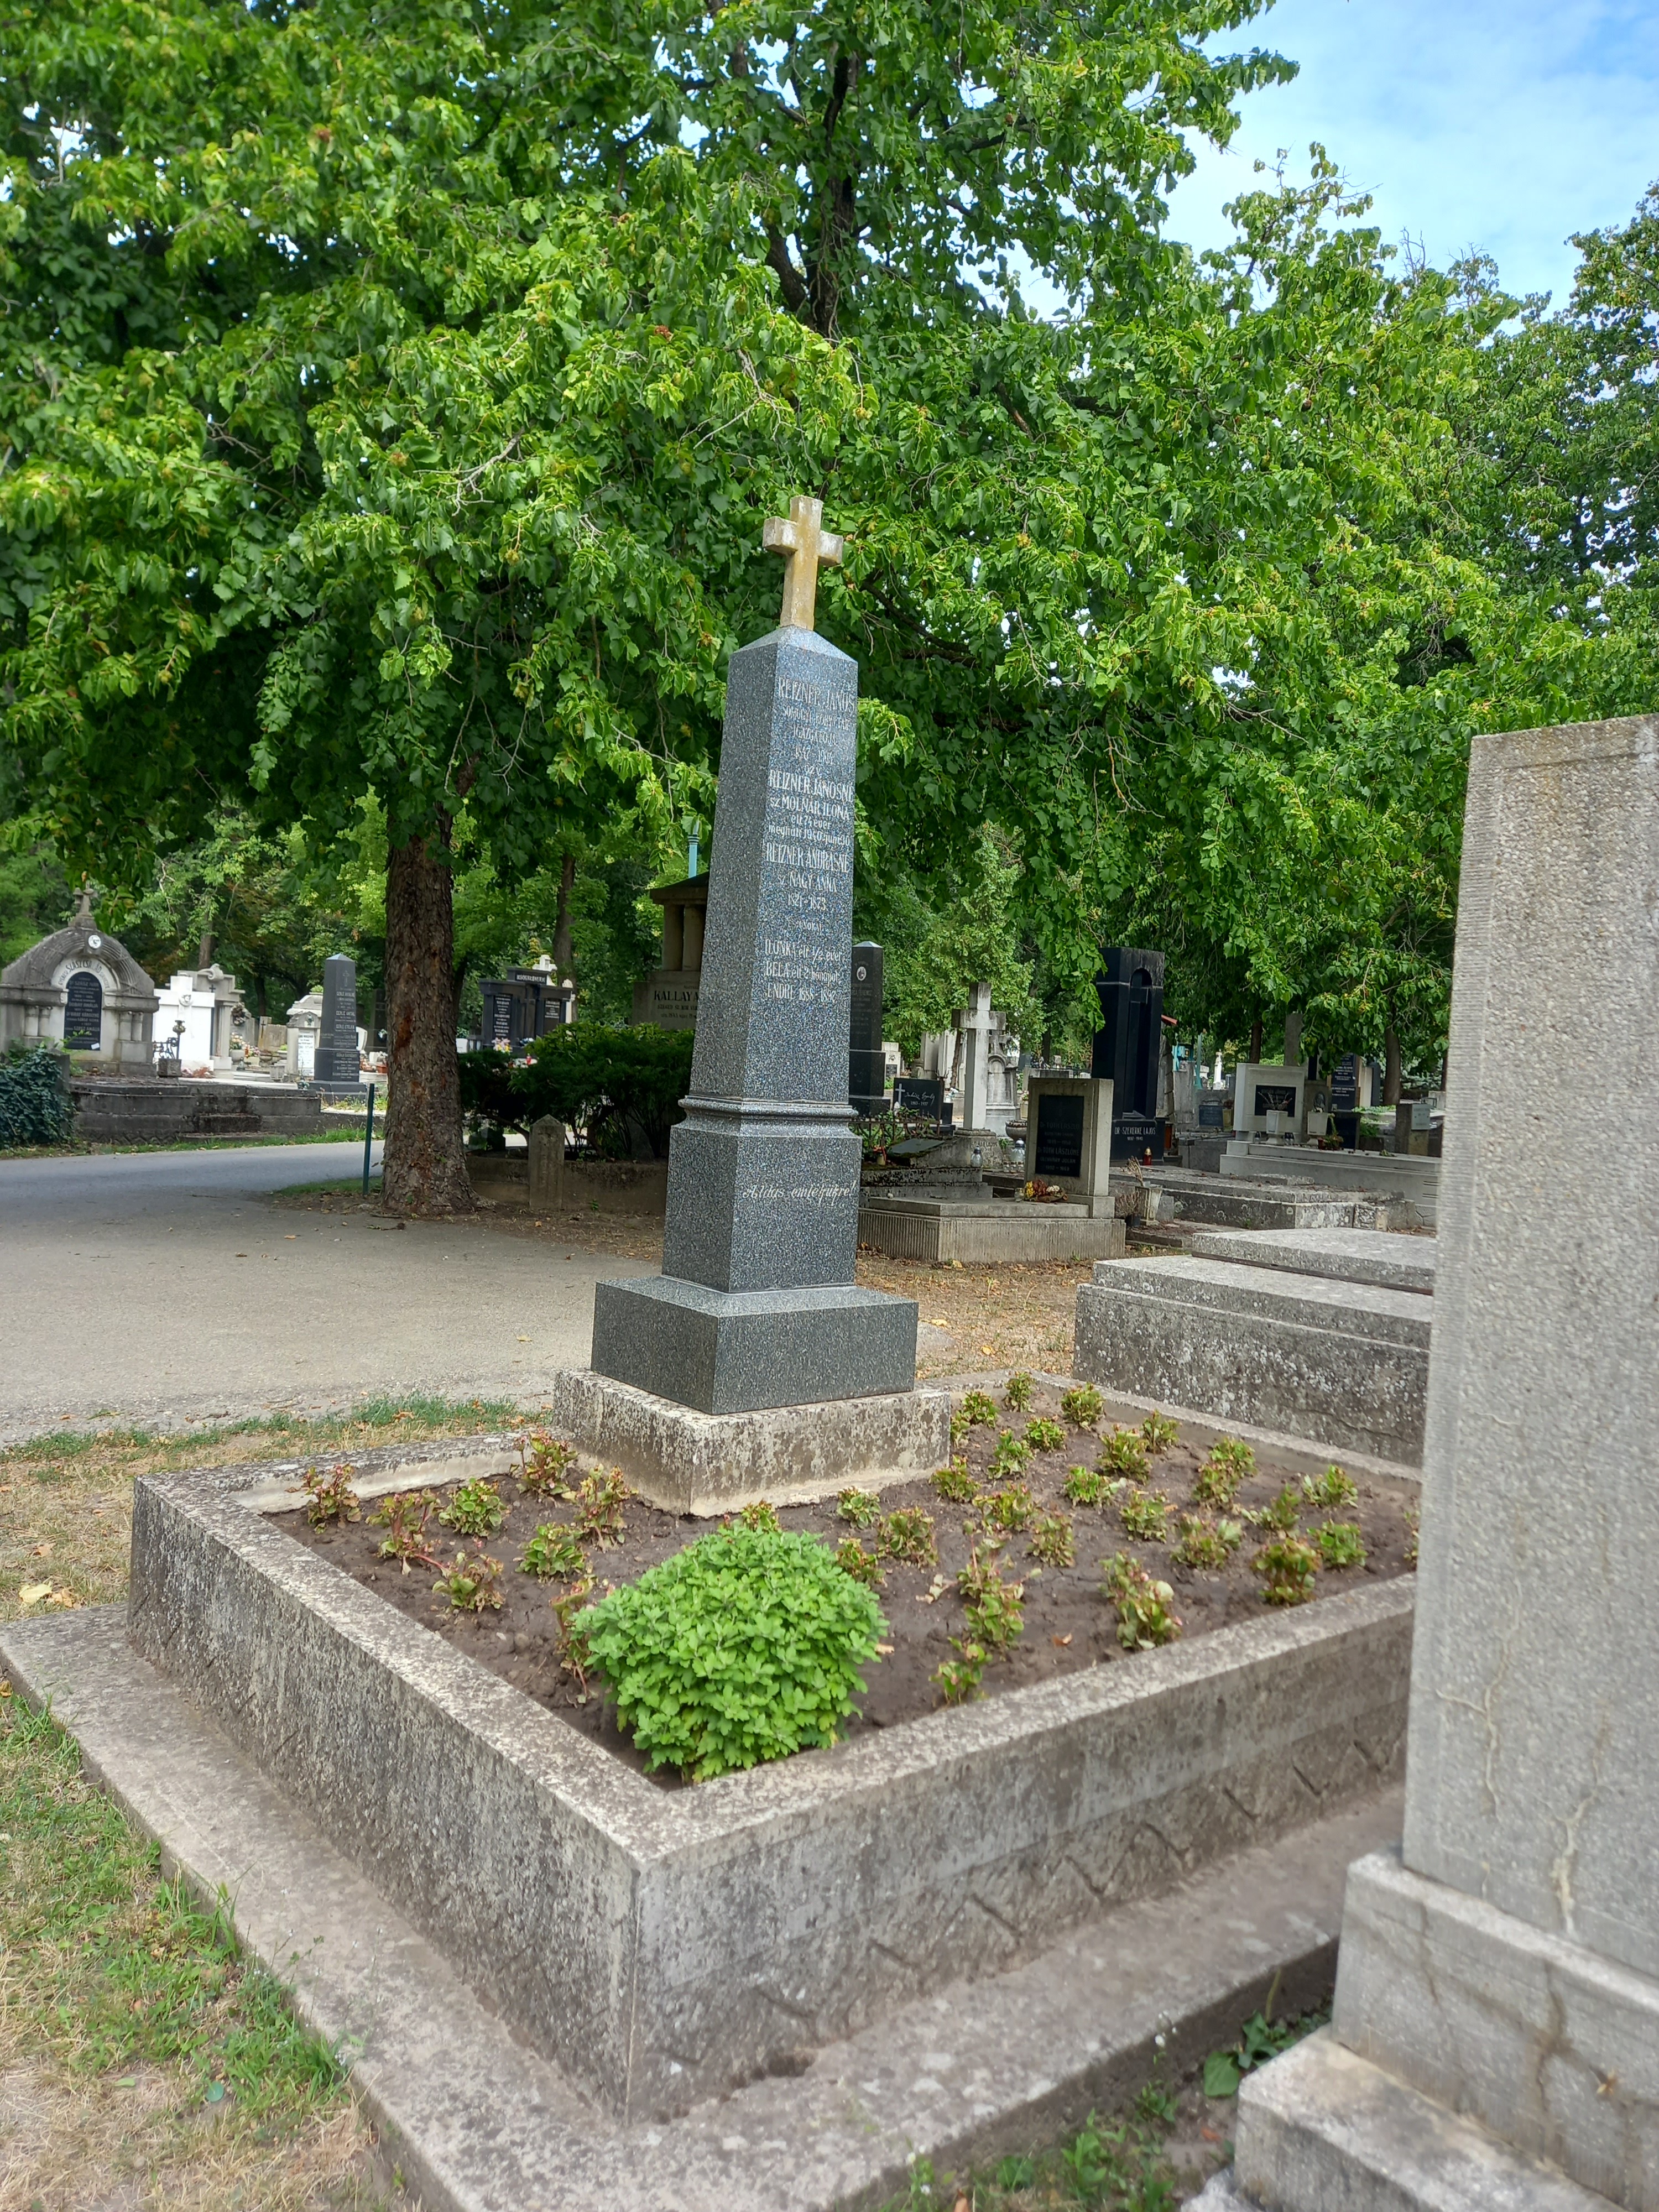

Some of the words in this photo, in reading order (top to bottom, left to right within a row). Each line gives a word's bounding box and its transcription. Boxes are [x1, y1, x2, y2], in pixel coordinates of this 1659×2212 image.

[778, 676, 821, 706] REIZNER
[769, 769, 811, 795] REIZNER
[822, 802, 850, 821] ILONA
[766, 842, 804, 867] REIZNER
[789, 872, 813, 889] NAGY
[815, 875, 837, 893] ANNA
[764, 938, 796, 961] ILONKA
[766, 957, 789, 978] BÉLA
[768, 982, 795, 999] ENDRE
[1143, 1126, 1156, 1135] LAJOS
